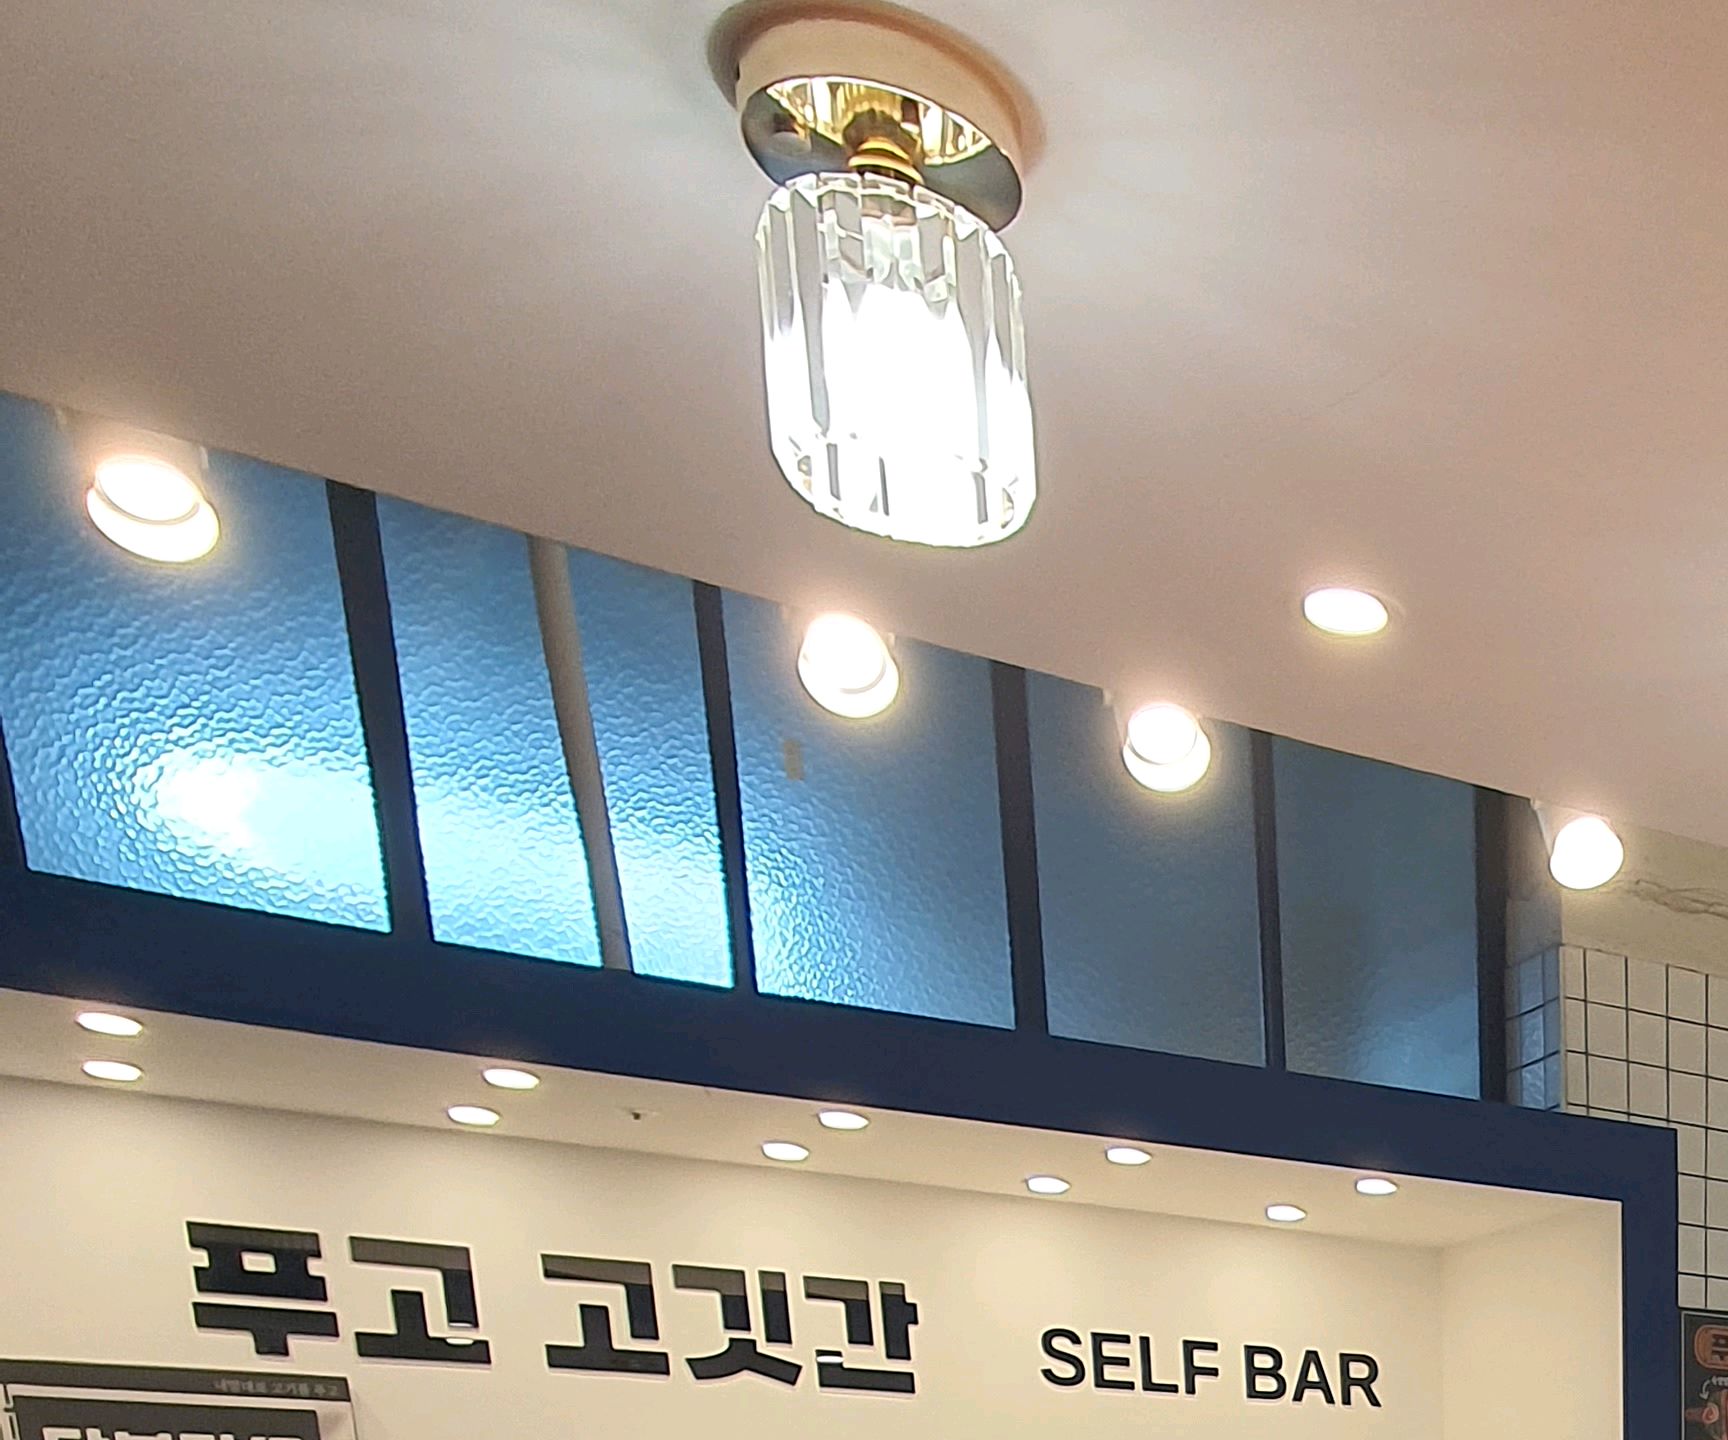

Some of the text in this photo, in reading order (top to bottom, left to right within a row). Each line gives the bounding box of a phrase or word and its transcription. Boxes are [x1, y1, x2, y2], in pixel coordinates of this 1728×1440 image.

[186, 1221, 919, 1394] 푸고 고깃간
[1040, 1328, 1382, 1407] SELF BAR
